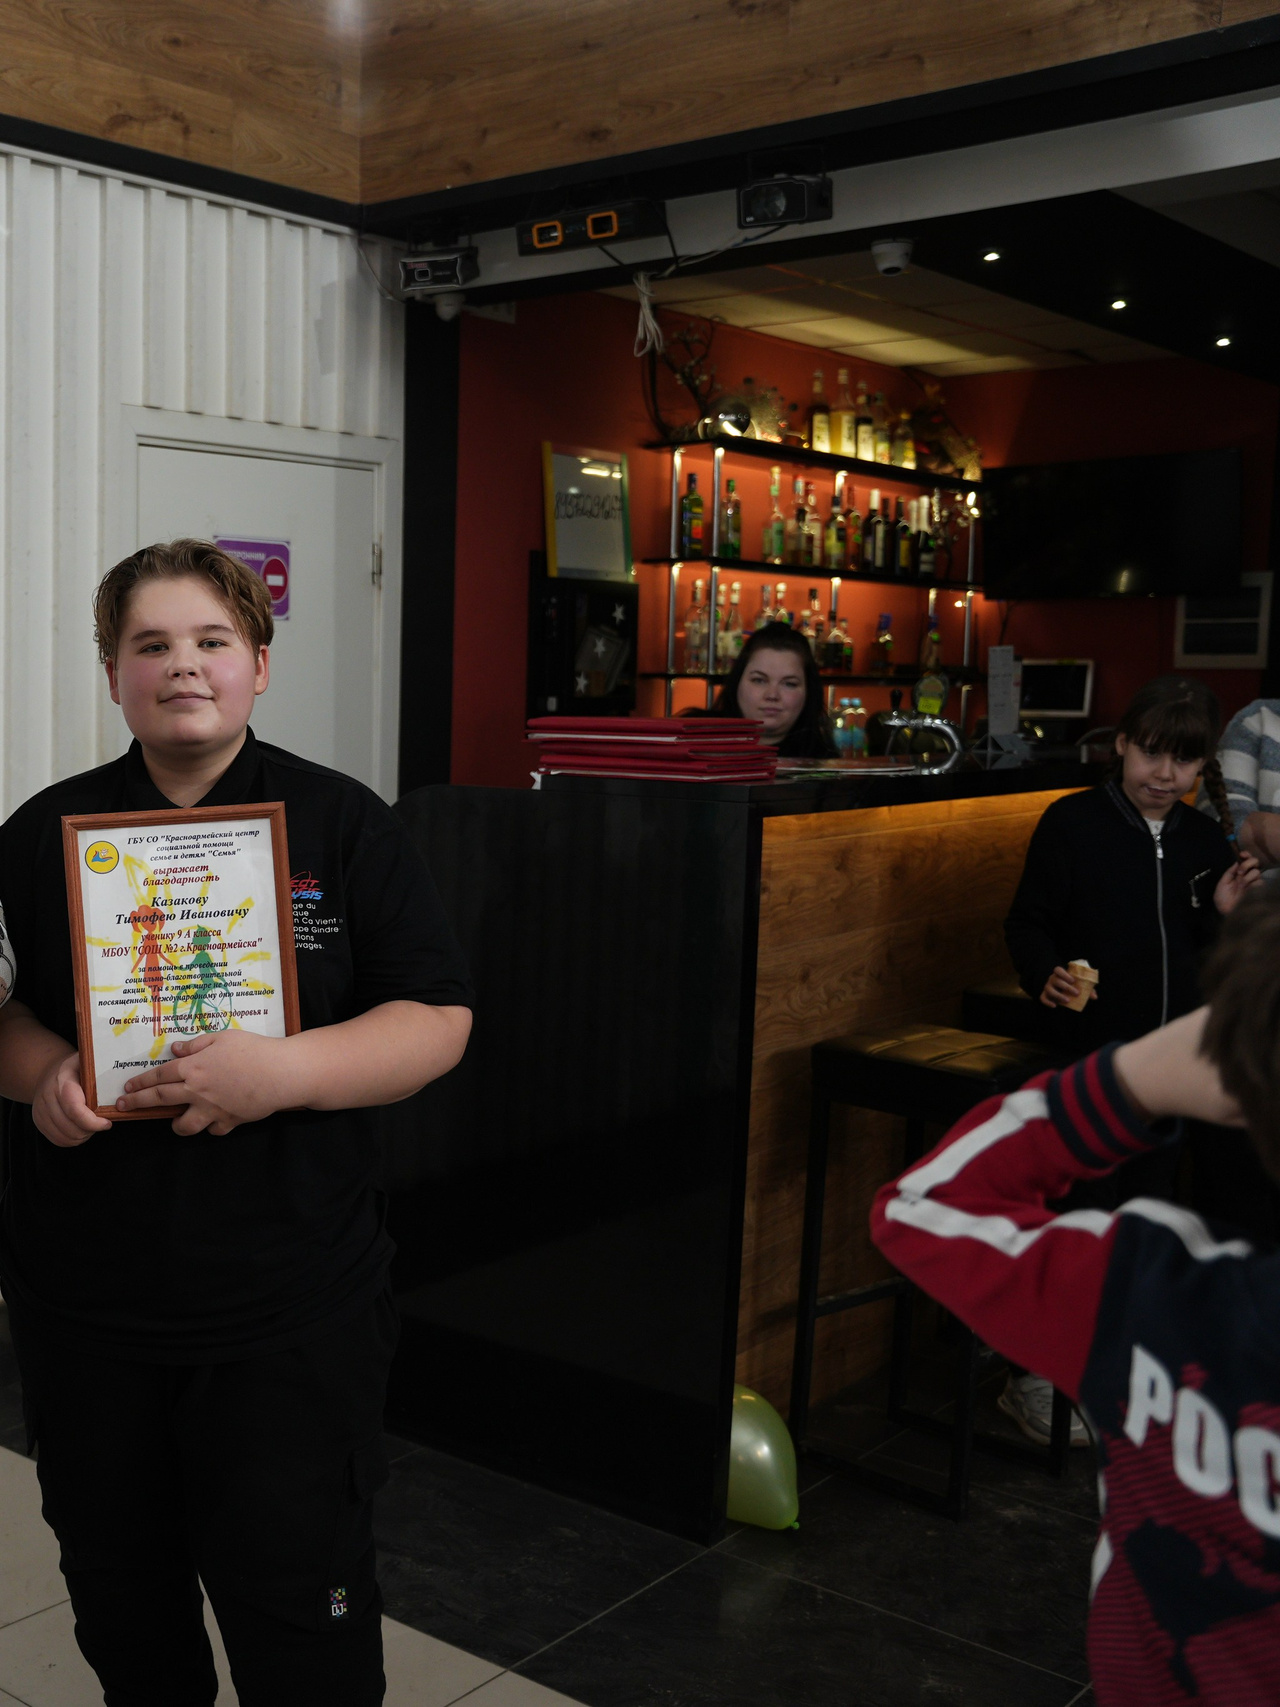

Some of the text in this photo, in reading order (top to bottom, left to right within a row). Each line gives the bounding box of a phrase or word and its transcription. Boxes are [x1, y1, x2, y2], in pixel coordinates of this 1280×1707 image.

[127, 836, 144, 844] ГБУ
[146, 835, 158, 843] СО
[161, 830, 232, 843] "Красноармейский
[156, 842, 200, 851] социальной
[208, 848, 241, 856] "Семья"
[153, 865, 208, 877] выражает
[143, 875, 220, 886] благодарность
[151, 896, 208, 907] Казакову
[116, 908, 249, 924] Тимофею Ивановичу
[141, 932, 175, 943] ученику
[193, 929, 221, 937] класса
[101, 937, 262, 957] МБОУ "СОШ №2 г.Красноармейска"
[185, 961, 228, 971] проведении
[125, 969, 242, 984] социально-благотворительной
[98, 988, 274, 1006] посвященной Международному дню инвалидов
[109, 1016, 121, 1025] От
[124, 1015, 139, 1024] всей
[141, 1015, 161, 1025] души
[163, 1013, 192, 1022] желаем
[195, 1010, 227, 1022] крепкого
[229, 1009, 261, 1019] здоровья
[159, 1024, 188, 1035] успехов
[197, 1021, 219, 1033] учебе!
[113, 1059, 174, 1069] Директор цент
